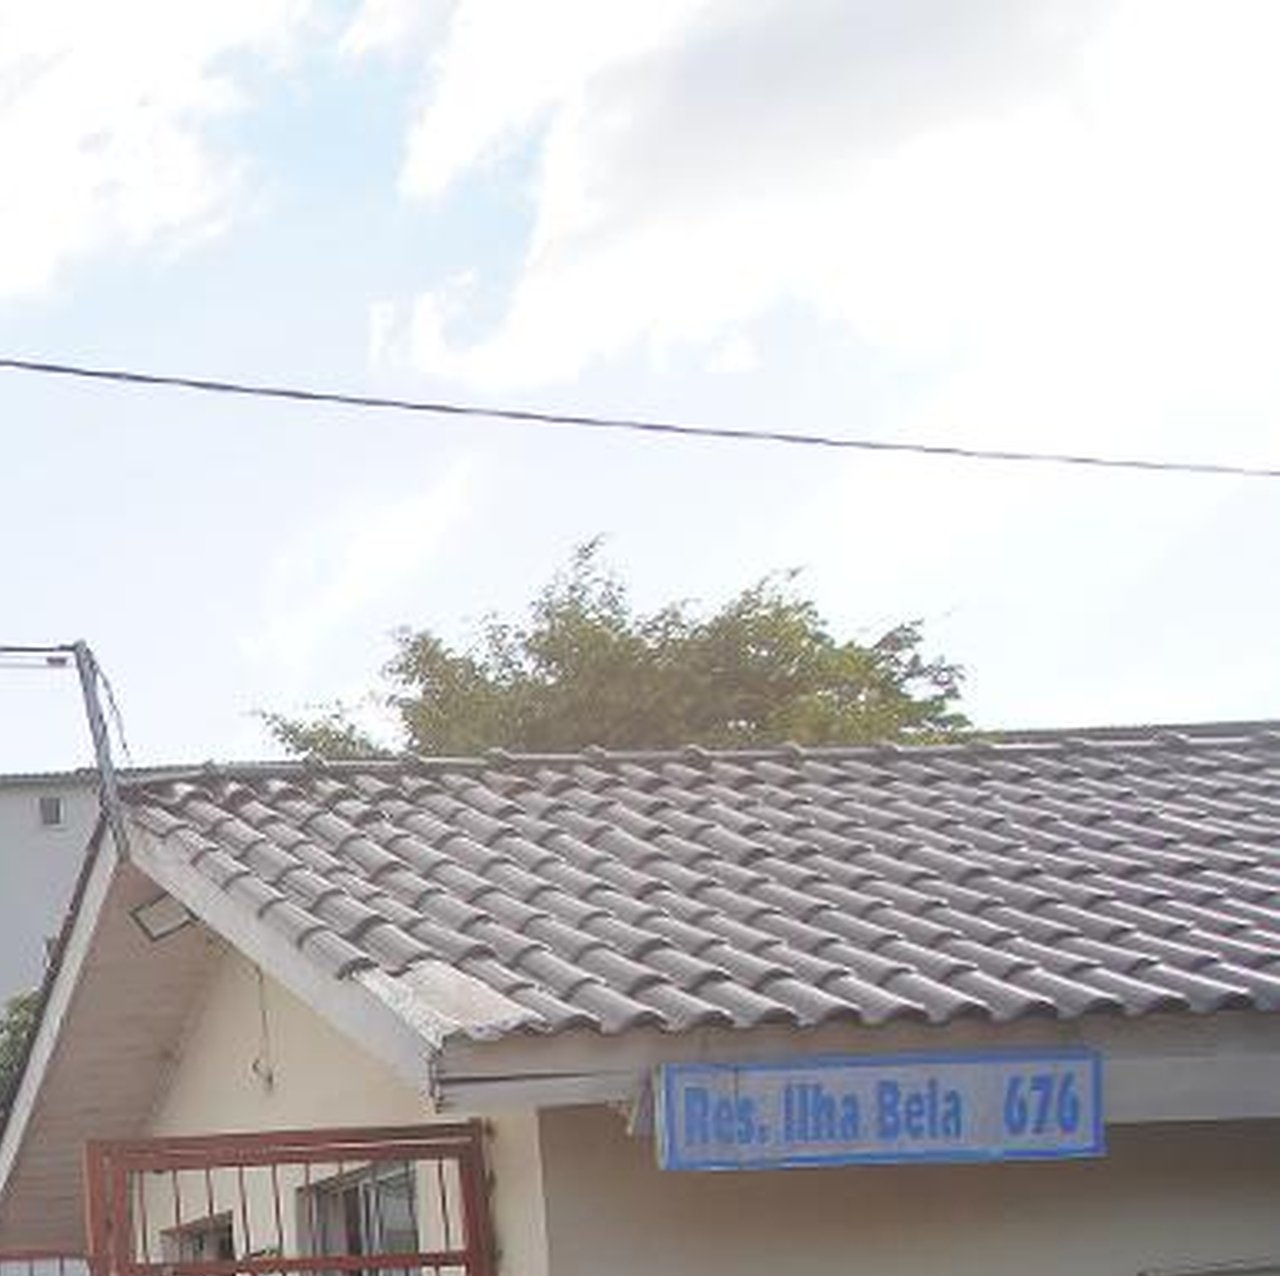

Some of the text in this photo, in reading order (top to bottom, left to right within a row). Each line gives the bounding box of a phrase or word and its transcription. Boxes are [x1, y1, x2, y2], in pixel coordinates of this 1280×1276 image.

[684, 1071, 1079, 1145] Res. Ilha Bela 676
